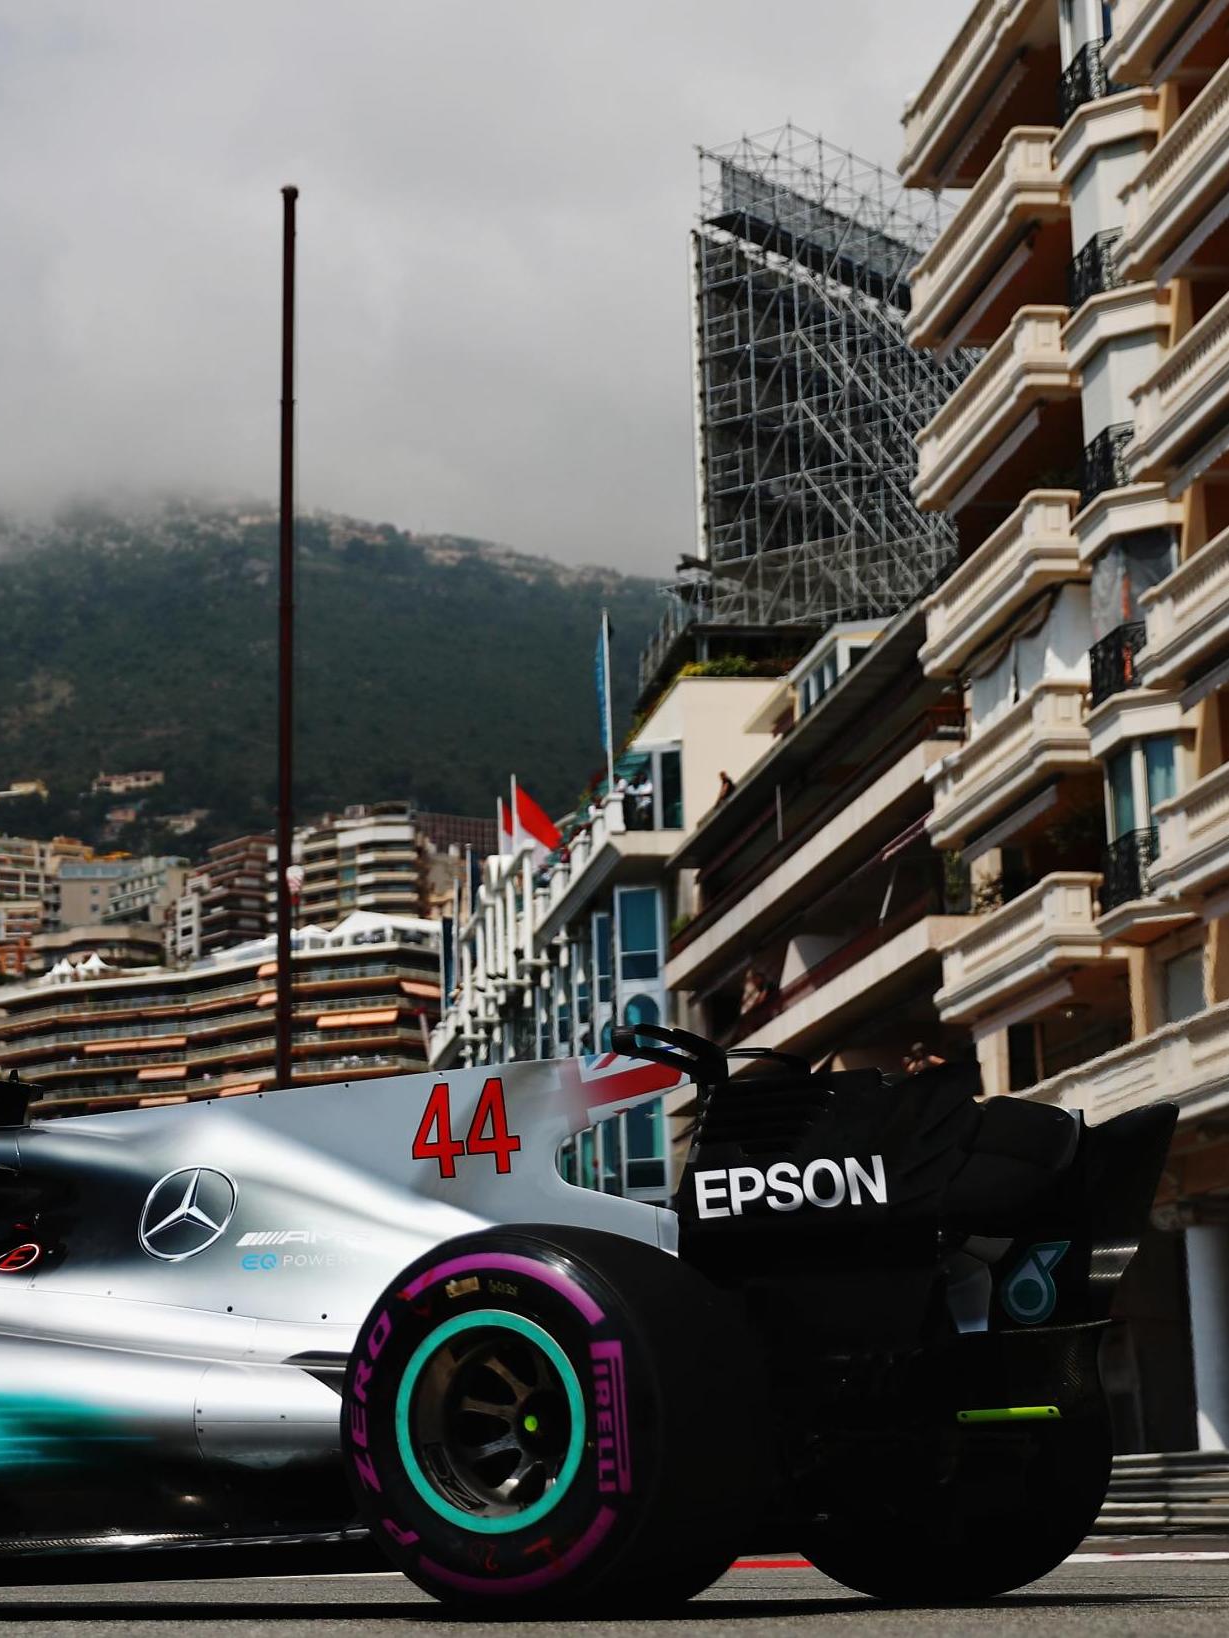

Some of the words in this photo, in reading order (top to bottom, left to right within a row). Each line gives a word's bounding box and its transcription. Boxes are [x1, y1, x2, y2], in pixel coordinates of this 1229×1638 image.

[412, 1077, 521, 1179] 44
[694, 1155, 887, 1219] EPSON
[241, 1253, 277, 1271] EQ
[277, 1230, 372, 1246] AM
[351, 1310, 393, 1493] ZERO
[590, 1340, 632, 1494] PIRELLI
